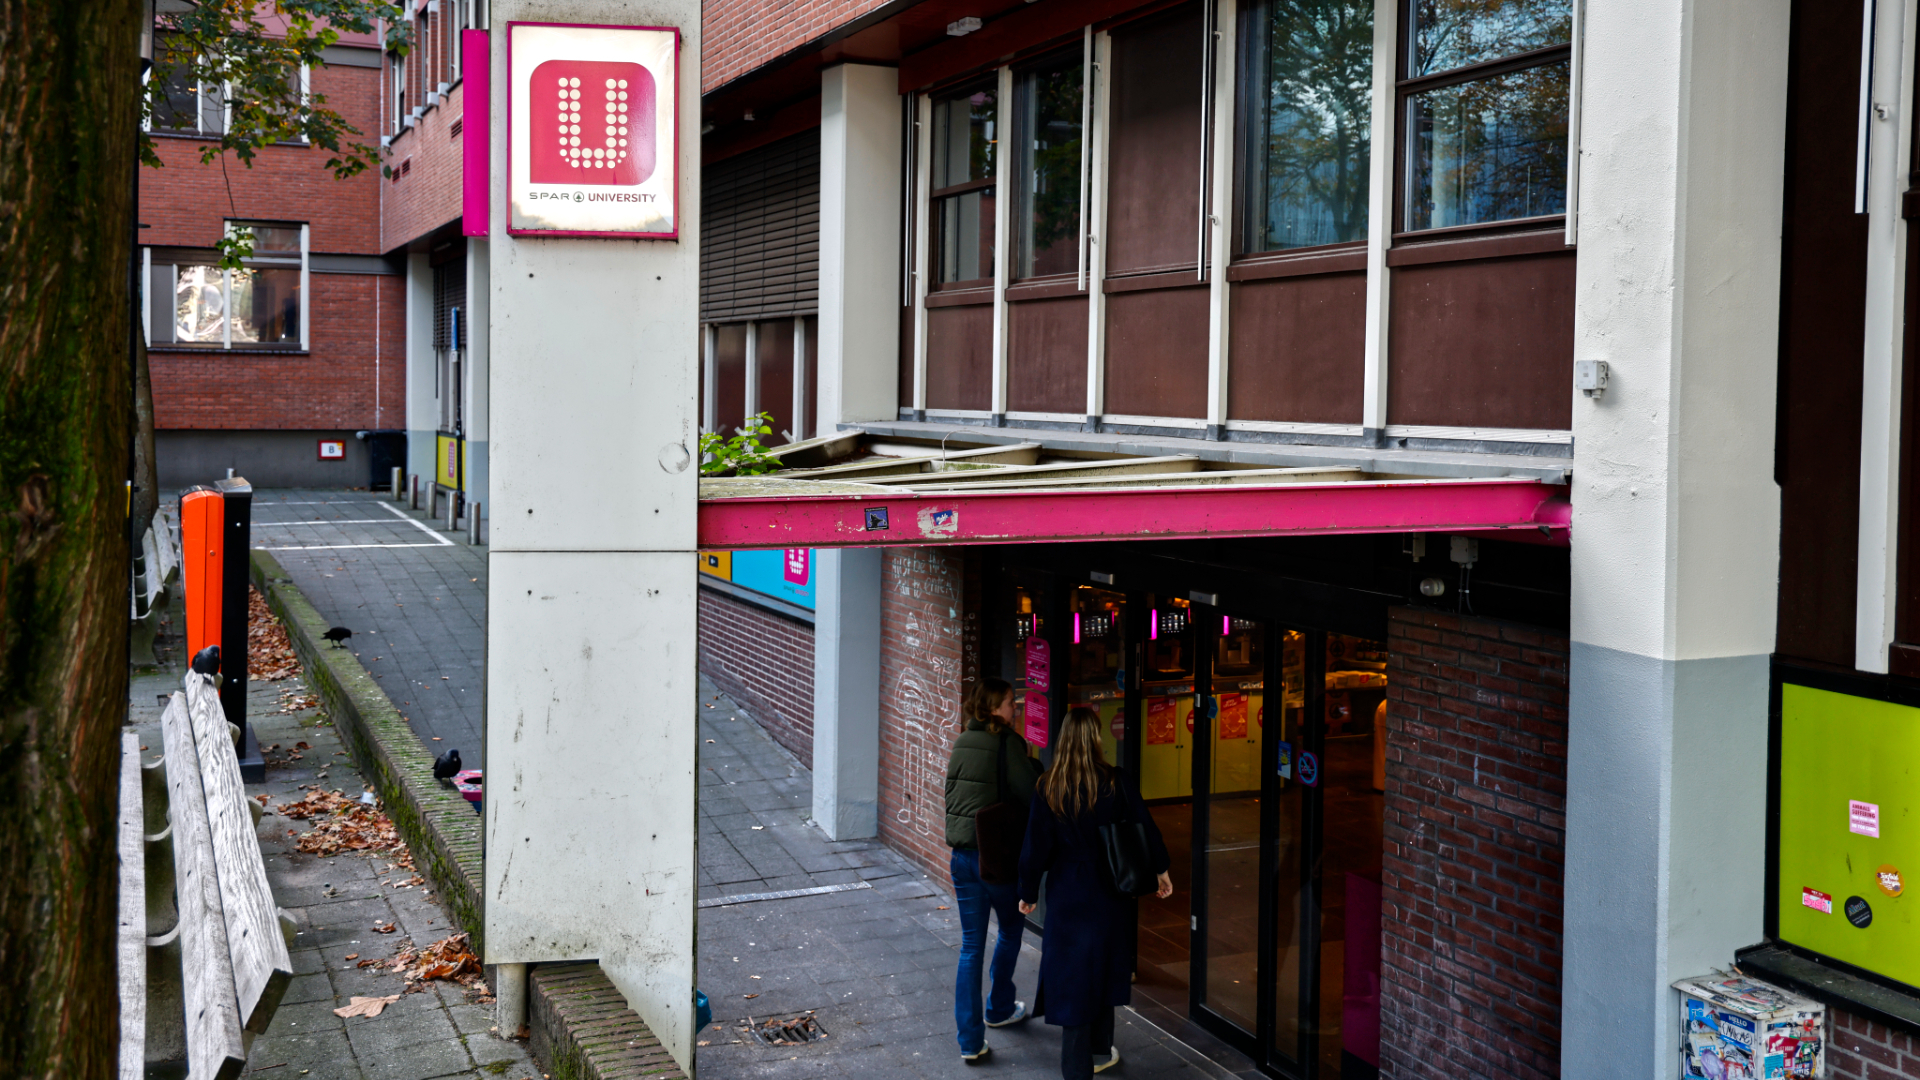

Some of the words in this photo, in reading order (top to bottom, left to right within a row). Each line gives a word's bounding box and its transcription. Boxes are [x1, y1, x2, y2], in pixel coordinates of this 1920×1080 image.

[558, 77, 628, 169] U
[529, 191, 570, 200] SPAR
[588, 193, 657, 203] UNIVERSITY
[1852, 809, 1876, 819] SUFFERING
[1728, 1015, 1748, 1027] HELLO
